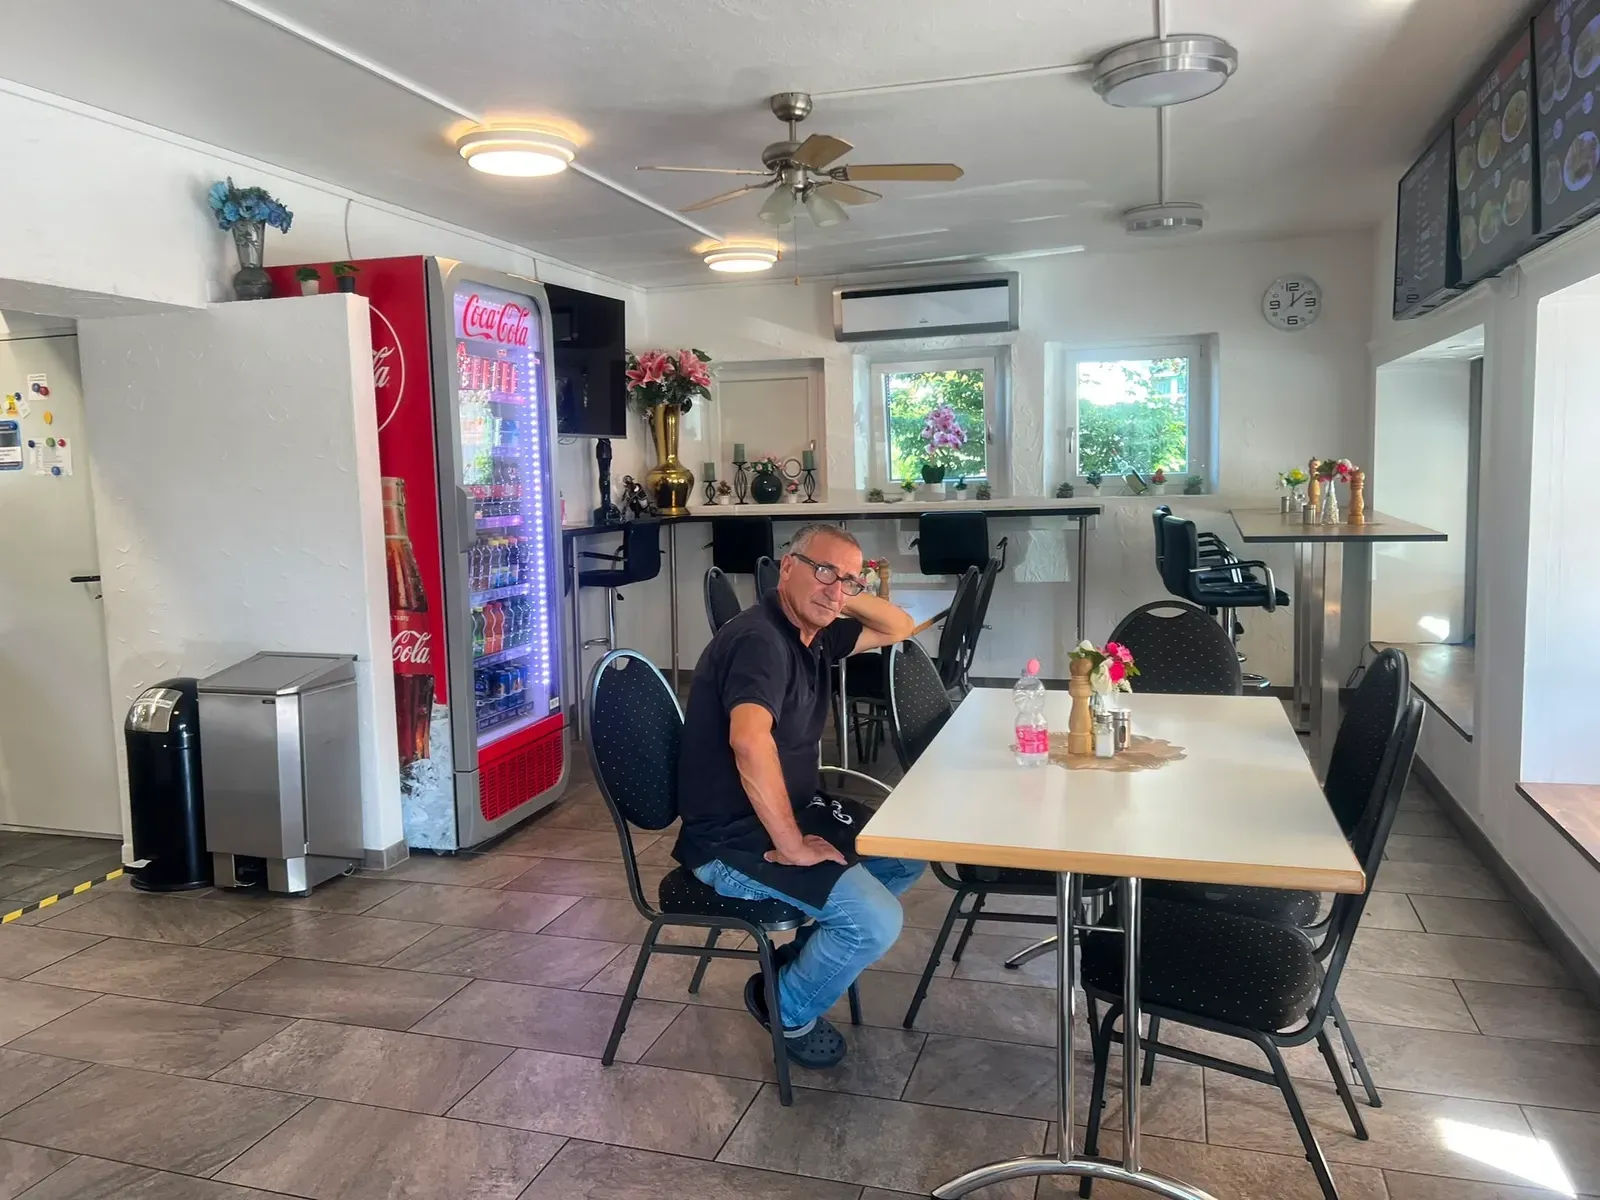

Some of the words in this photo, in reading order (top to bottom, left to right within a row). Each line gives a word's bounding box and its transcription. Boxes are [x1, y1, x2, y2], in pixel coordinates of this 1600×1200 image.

[1285, 282, 1300, 292] 12
[1269, 300, 1281, 310] 9
[1304, 297, 1317, 307] 3
[1286, 315, 1299, 325] 6
